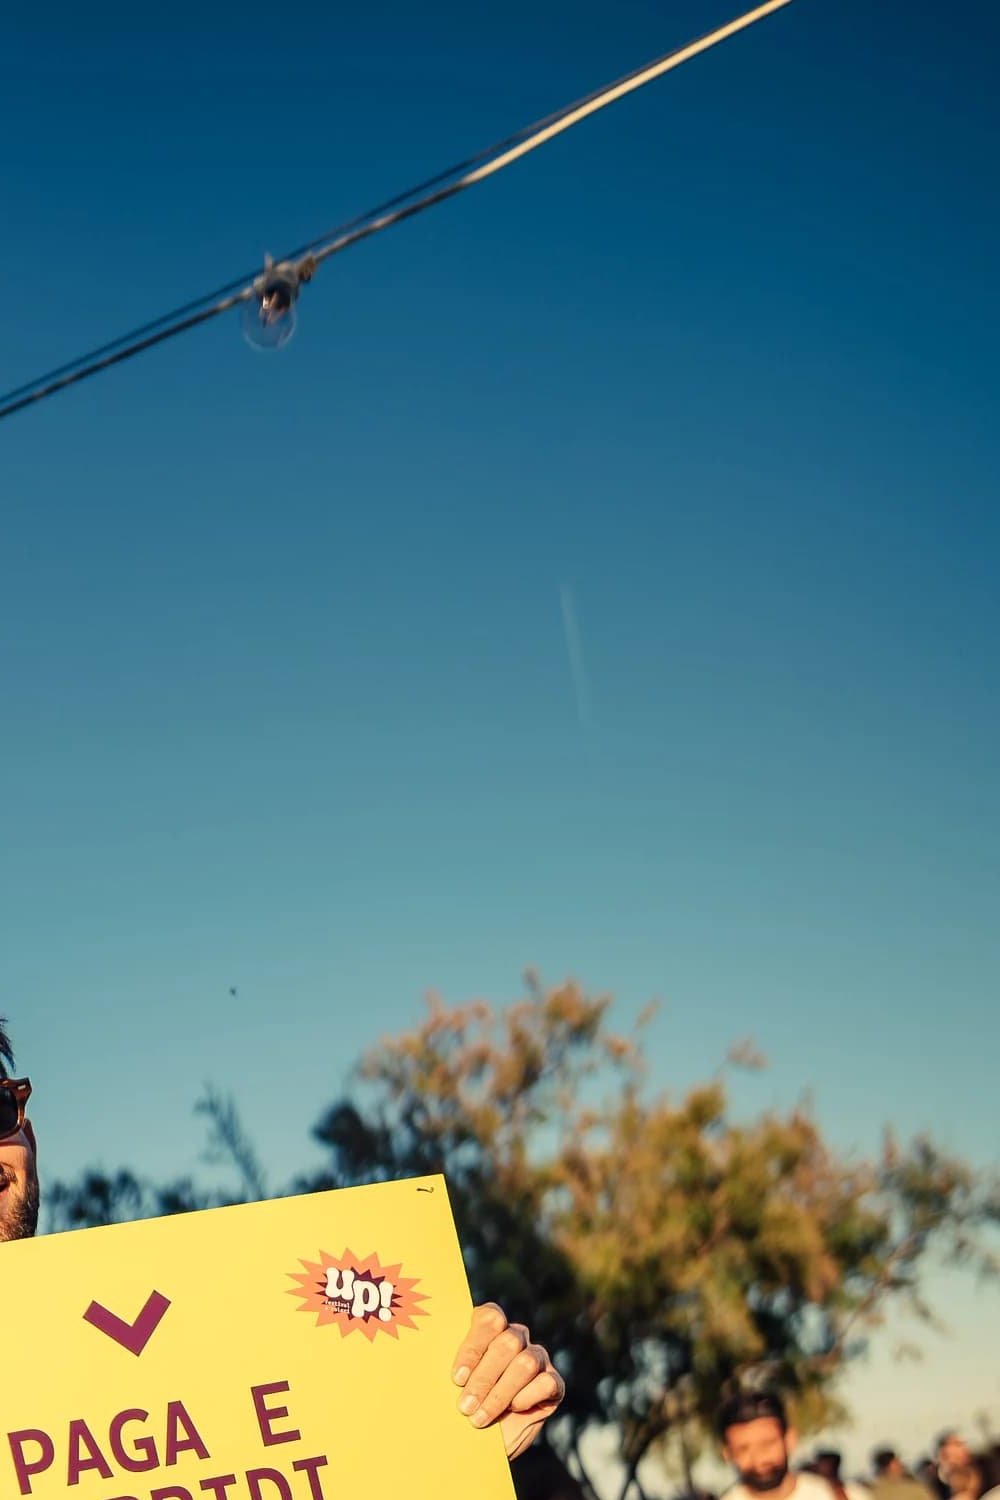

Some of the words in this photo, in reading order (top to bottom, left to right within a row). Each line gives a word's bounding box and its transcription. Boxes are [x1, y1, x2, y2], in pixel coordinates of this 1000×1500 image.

[325, 1266, 394, 1322] up!
[7, 1400, 210, 1495] PAGA
[251, 1381, 301, 1447] E
